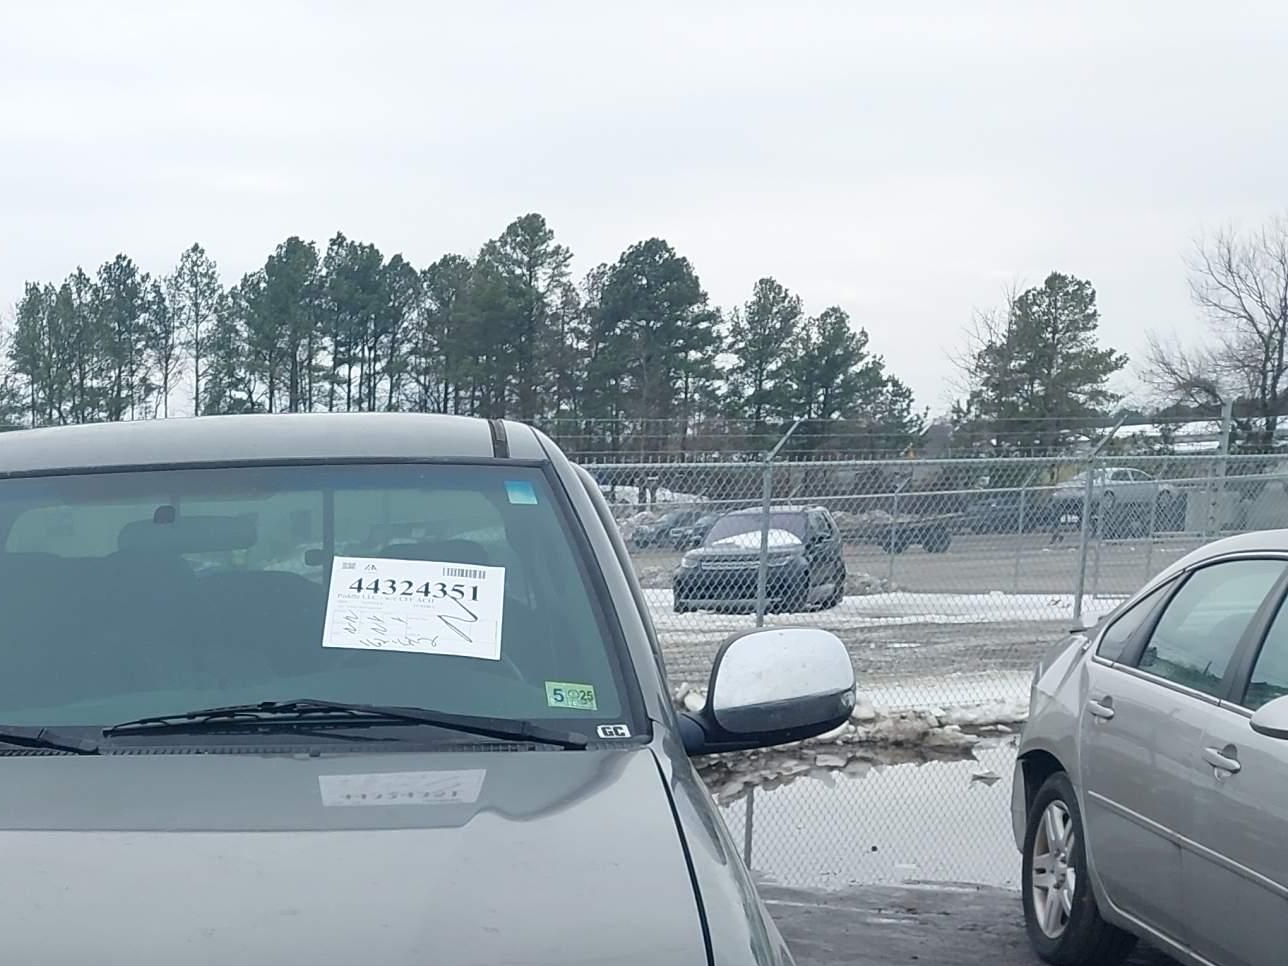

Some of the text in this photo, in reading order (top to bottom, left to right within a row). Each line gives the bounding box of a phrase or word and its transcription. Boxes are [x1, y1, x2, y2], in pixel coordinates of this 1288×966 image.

[349, 577, 480, 602] 44324351
[553, 688, 594, 703] 5 25
[601, 726, 626, 737] GC
